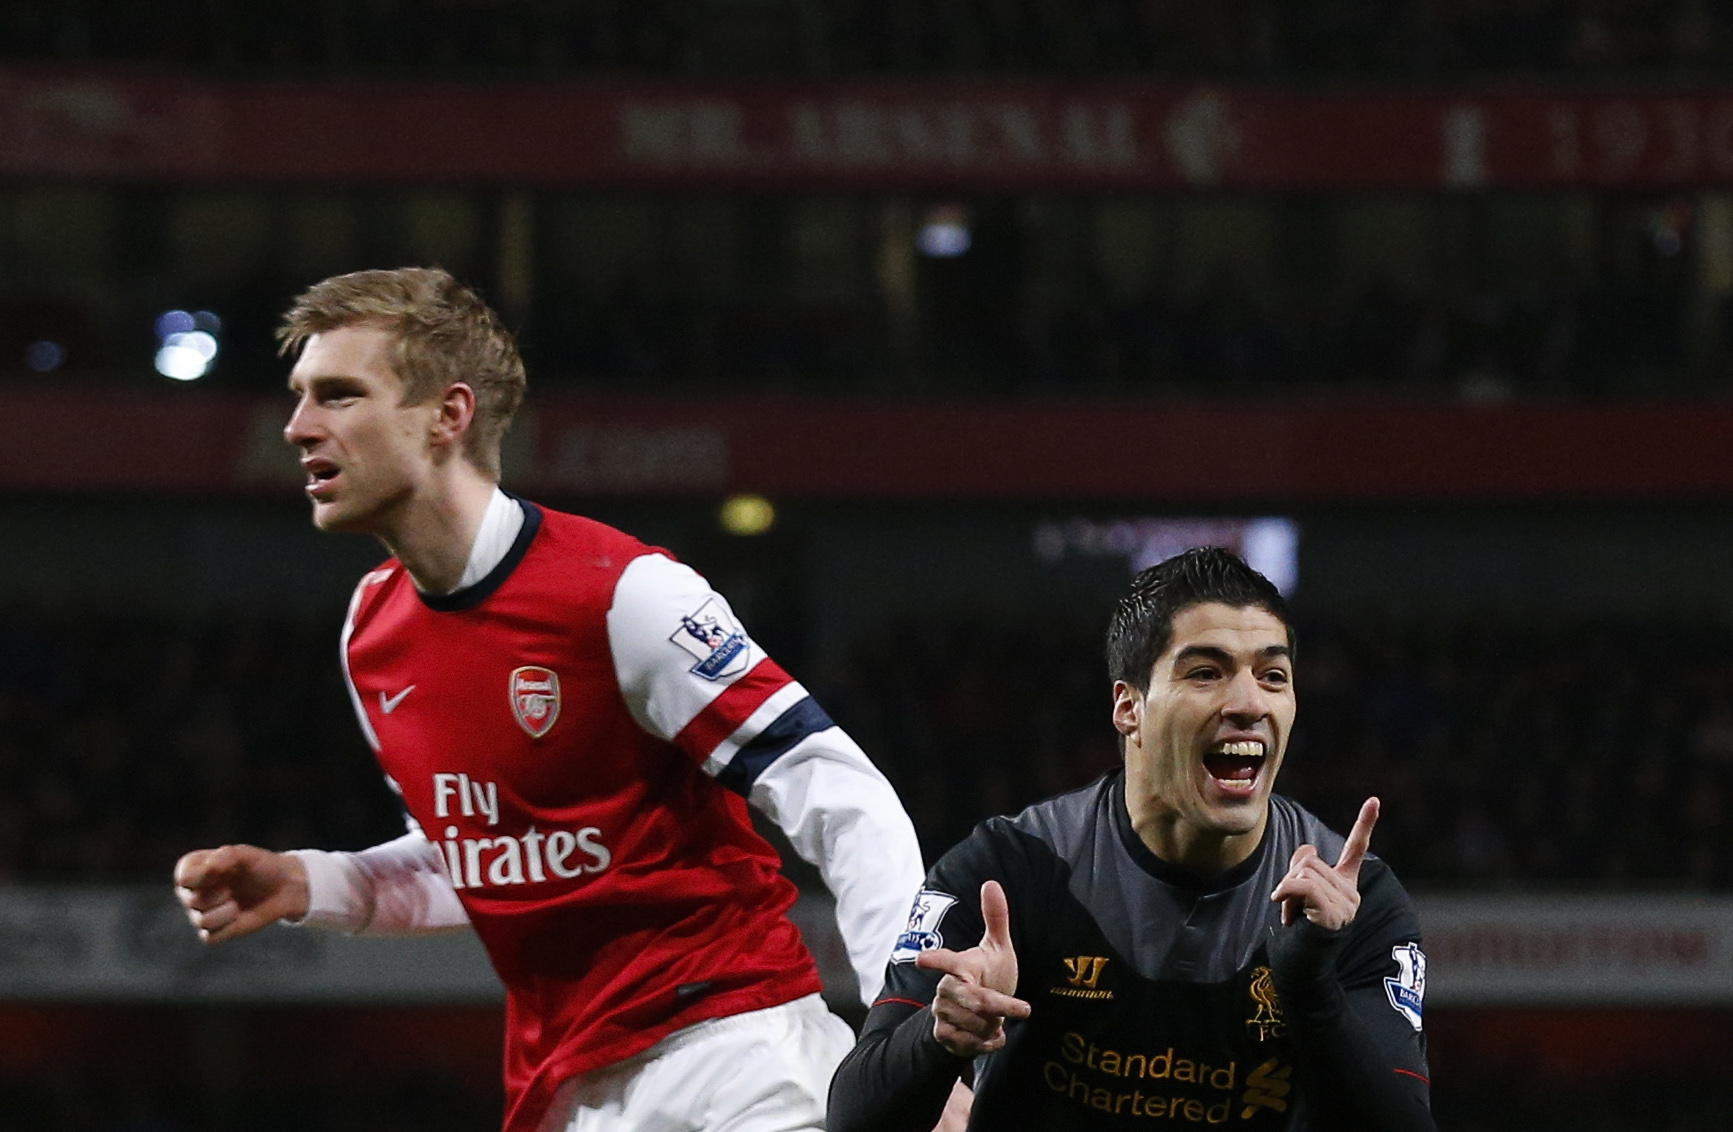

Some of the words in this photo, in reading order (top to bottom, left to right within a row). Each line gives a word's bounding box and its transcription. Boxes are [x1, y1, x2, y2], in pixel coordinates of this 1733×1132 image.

[434, 773, 498, 825] Fly
[432, 823, 612, 889] irates
[1061, 1031, 1237, 1091] Standard
[1043, 1060, 1232, 1125] Chartered
